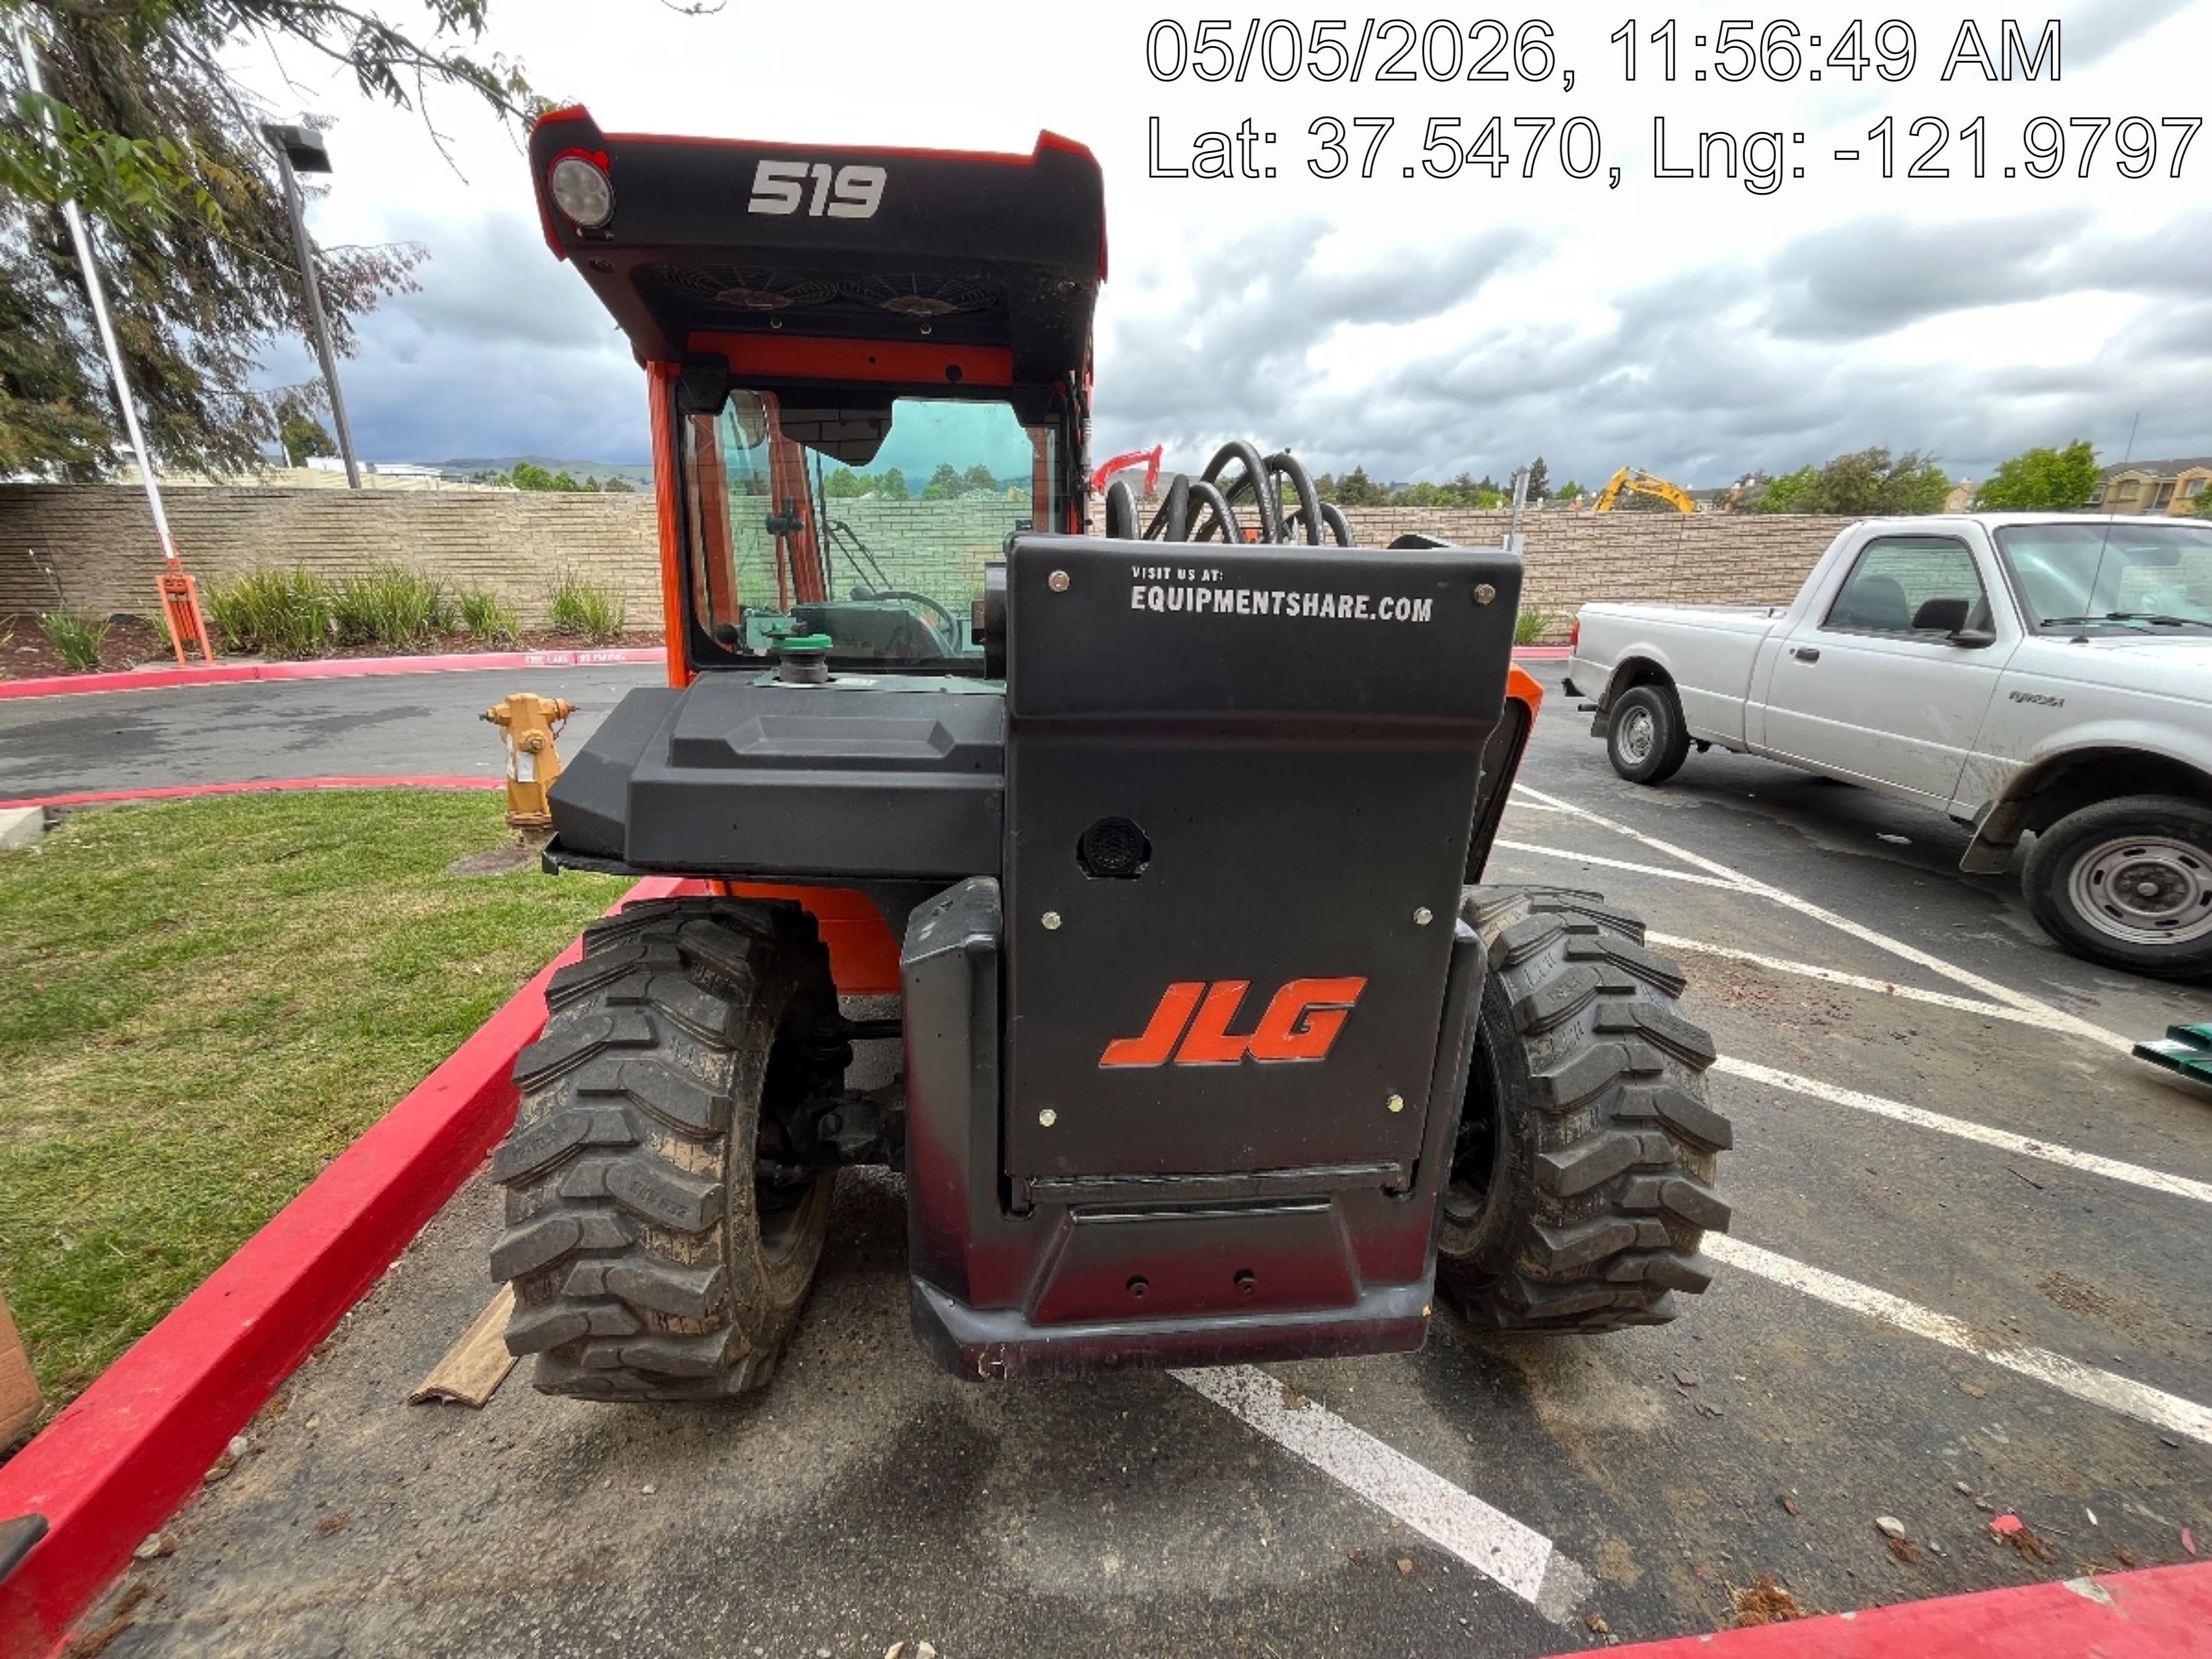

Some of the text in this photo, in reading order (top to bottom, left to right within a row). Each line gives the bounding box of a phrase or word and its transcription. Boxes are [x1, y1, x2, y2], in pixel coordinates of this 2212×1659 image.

[748, 160, 887, 218] 519
[1131, 565, 1223, 581] VISIT US AT:
[1131, 586, 1433, 622] EQUIPMENTSHARE.COM
[1099, 976, 1368, 1068] JLG
